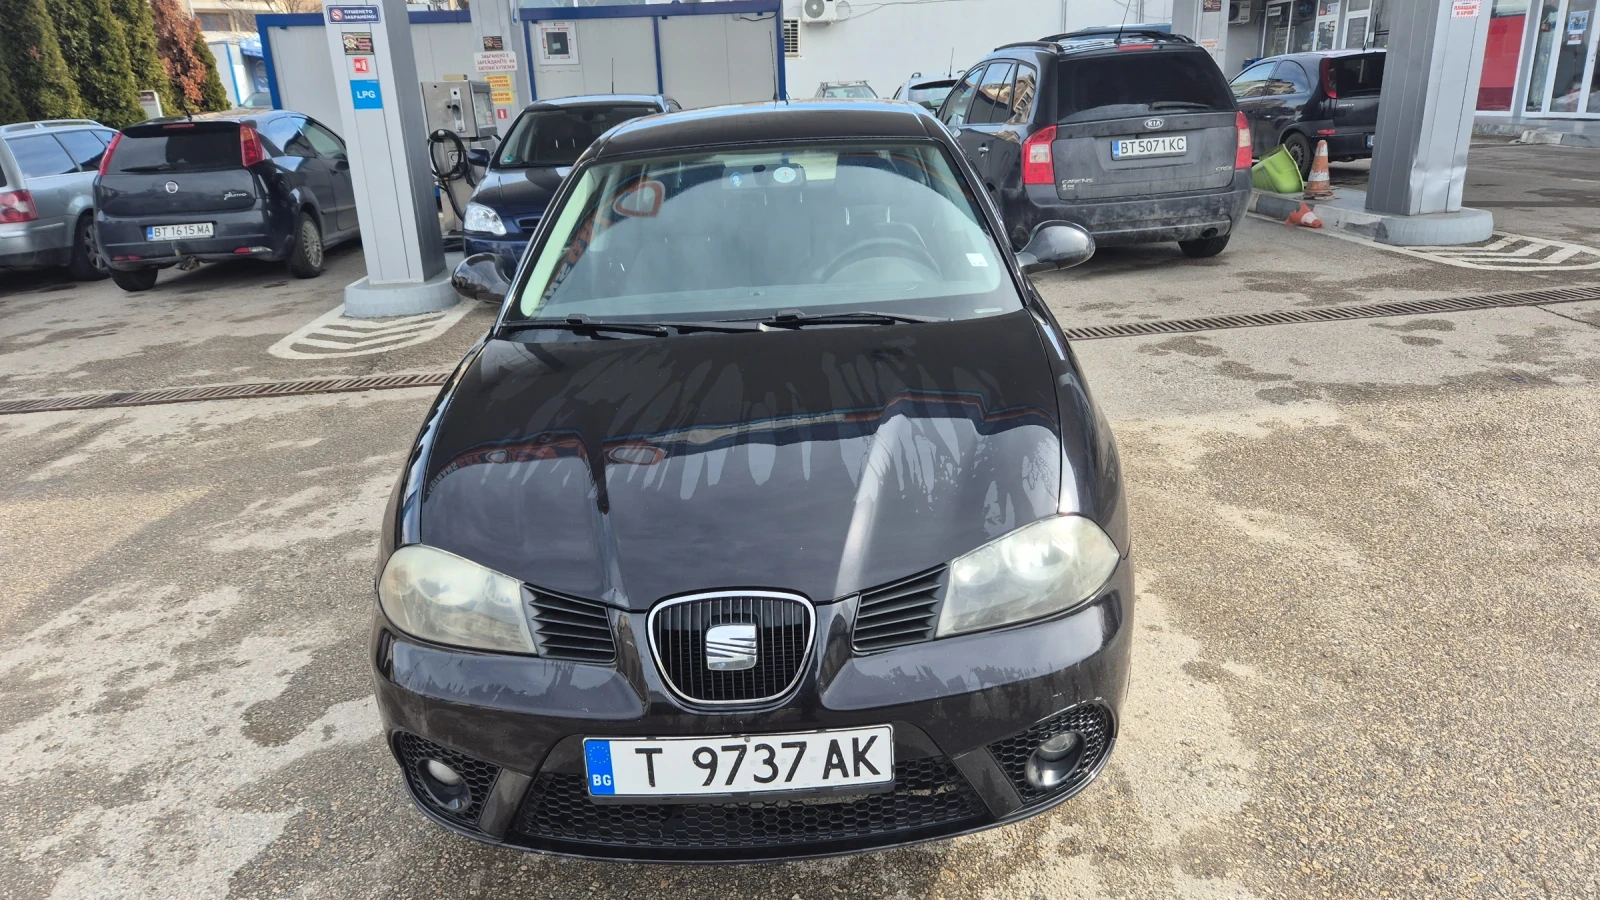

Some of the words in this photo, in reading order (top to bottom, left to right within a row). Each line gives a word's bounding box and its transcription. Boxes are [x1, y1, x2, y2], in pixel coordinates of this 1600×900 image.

[356, 90, 376, 99] LPG
[1121, 141, 1136, 154] BT
[1138, 140, 1166, 153] 5071
[1169, 138, 1184, 151] KC
[154, 227, 167, 237] BT
[171, 225, 195, 236] 1615
[197, 225, 211, 235] MA
[635, 747, 663, 787] T
[692, 741, 807, 787] 9737
[822, 735, 881, 780] AK
[593, 774, 612, 787] BG
